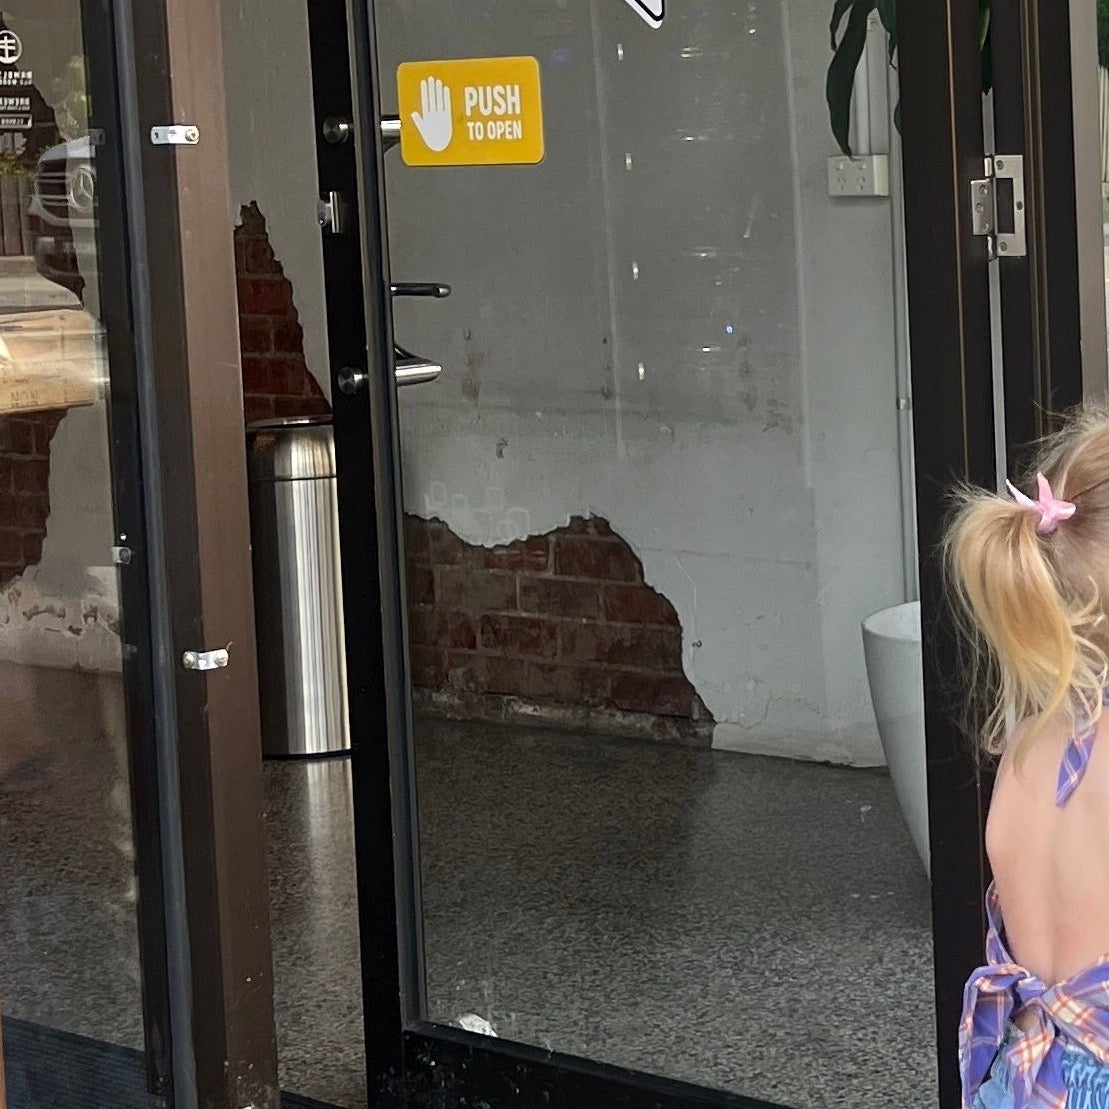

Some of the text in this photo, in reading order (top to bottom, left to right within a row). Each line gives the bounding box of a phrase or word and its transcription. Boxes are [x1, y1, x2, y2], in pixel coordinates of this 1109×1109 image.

[464, 85, 521, 116] PUSH
[467, 120, 523, 140] TO OPEN
